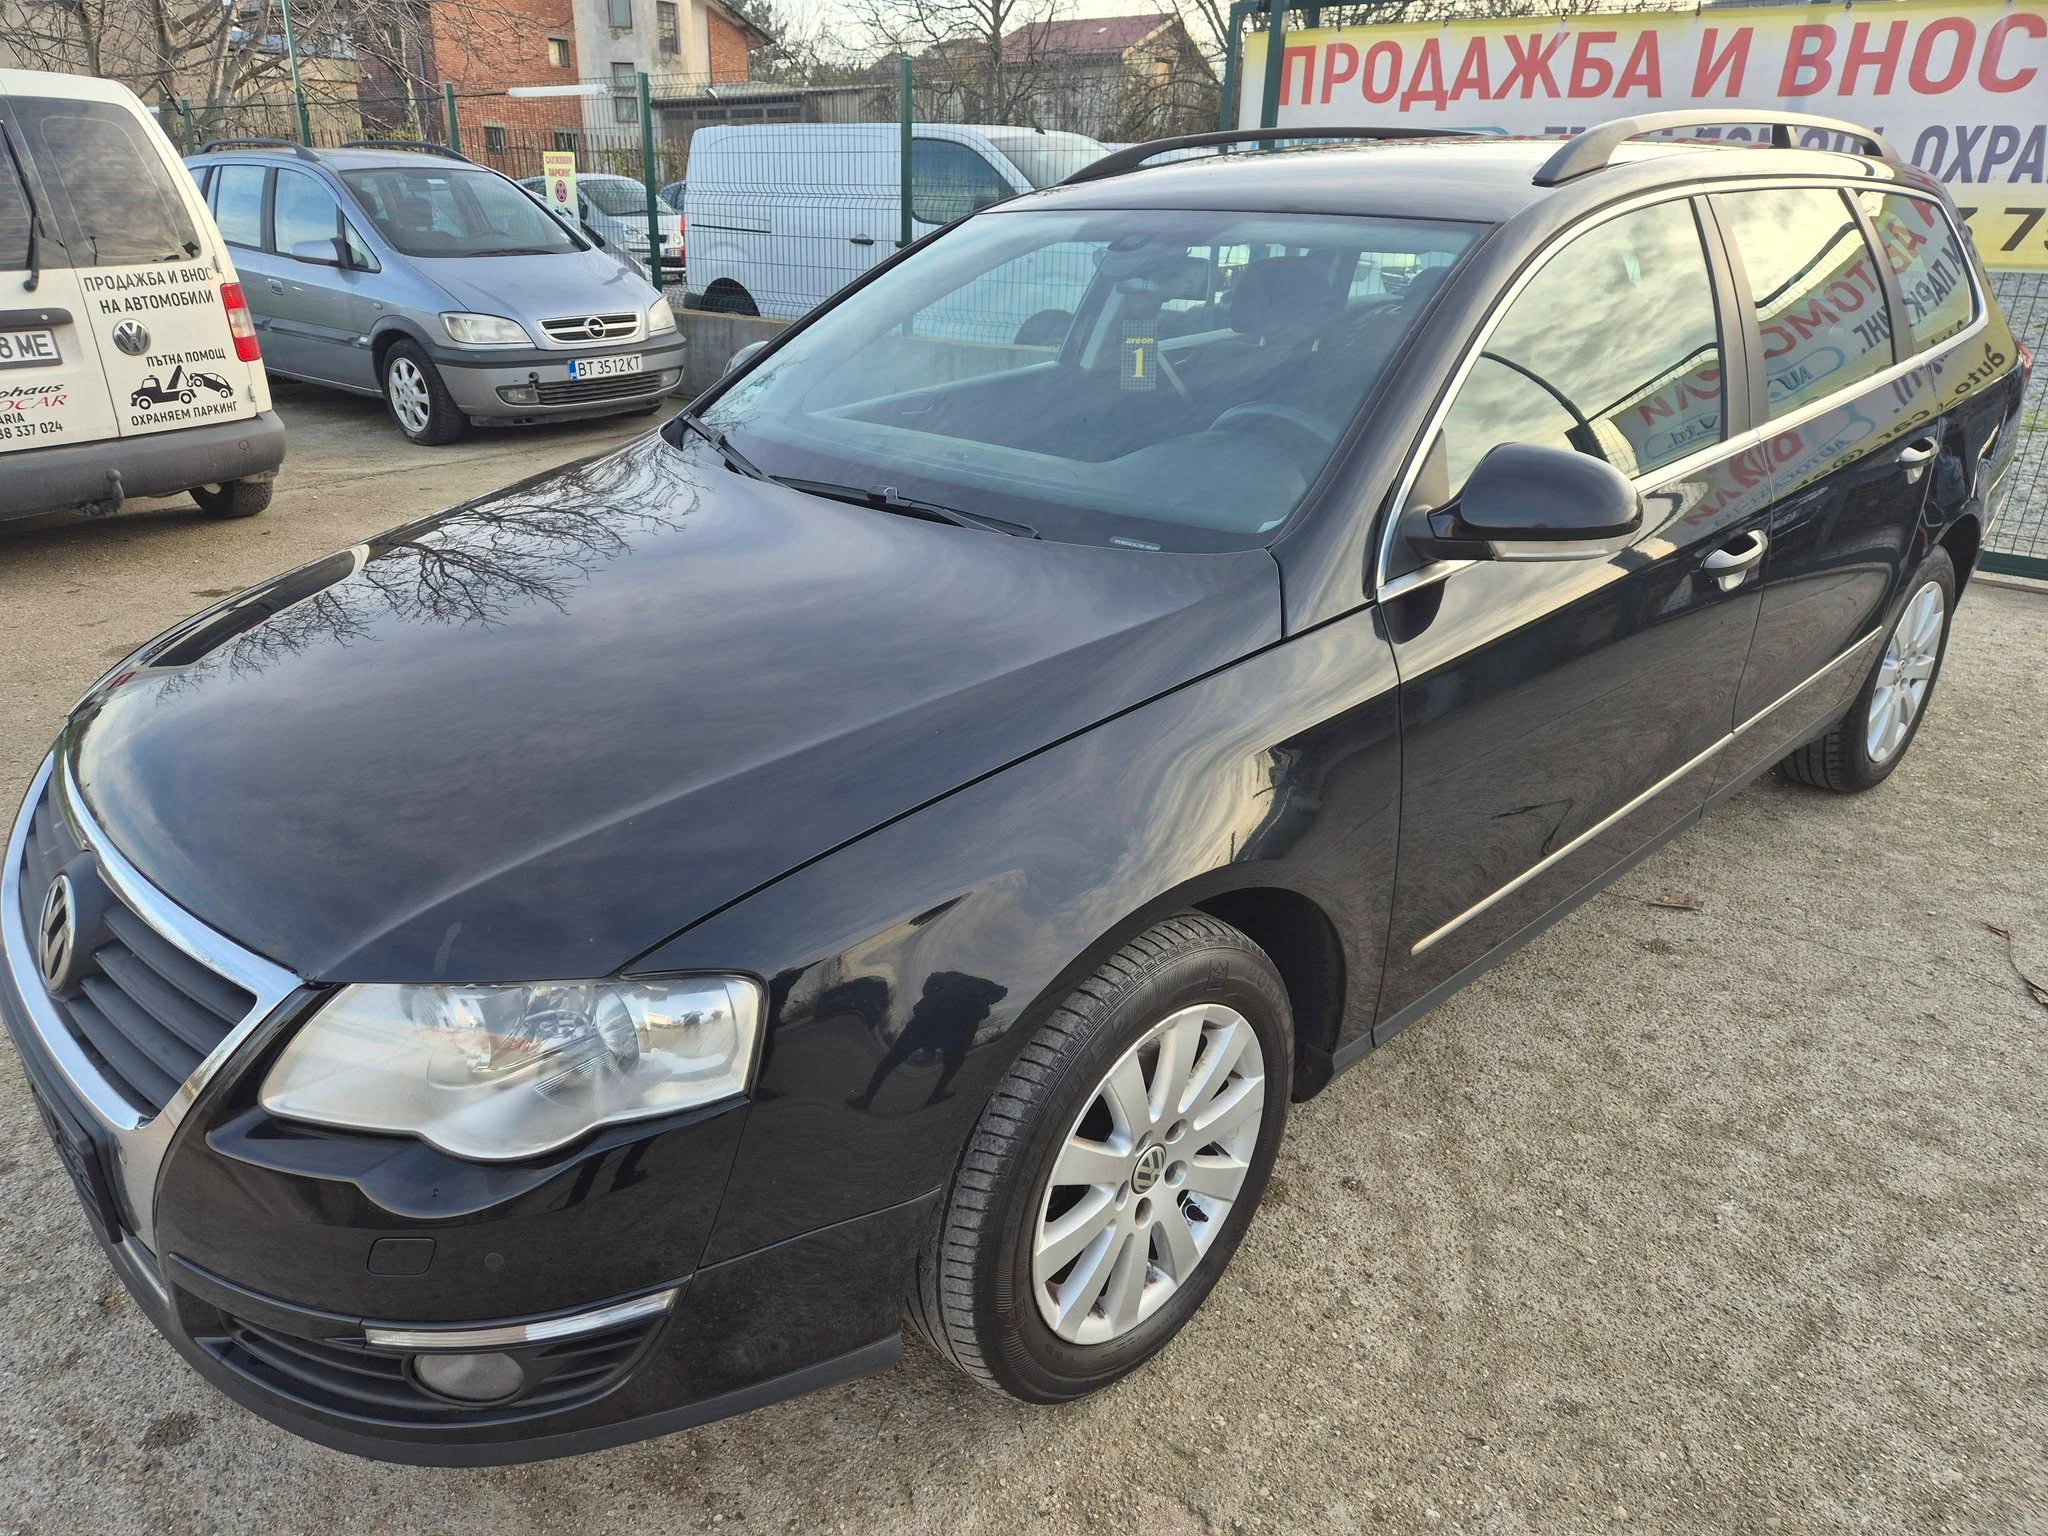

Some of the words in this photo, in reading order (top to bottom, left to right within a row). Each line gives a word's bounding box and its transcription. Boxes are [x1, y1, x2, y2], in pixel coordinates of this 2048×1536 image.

[1279, 30, 1663, 112] ПРОДАЖБА
[1691, 27, 1754, 98] И
[1777, 13, 2048, 97] ВНОС
[2000, 207, 2048, 252] 7
[83, 271, 166, 291] ПРОДАЖБА
[168, 270, 178, 284] И
[180, 267, 213, 283] ВНОС
[99, 299, 122, 315] НА
[125, 289, 215, 312] АВТОМОБИЛИ
[15, 334, 53, 358] ME
[146, 353, 184, 367] ПЪТНА
[185, 348, 227, 363] ПОМОЩ
[1131, 347, 1145, 377] 1
[131, 407, 191, 427] ОХРАНЯЕМ
[193, 401, 237, 418] ПАРКИНГ
[15, 424, 36, 438] 337
[40, 421, 63, 434] 024
